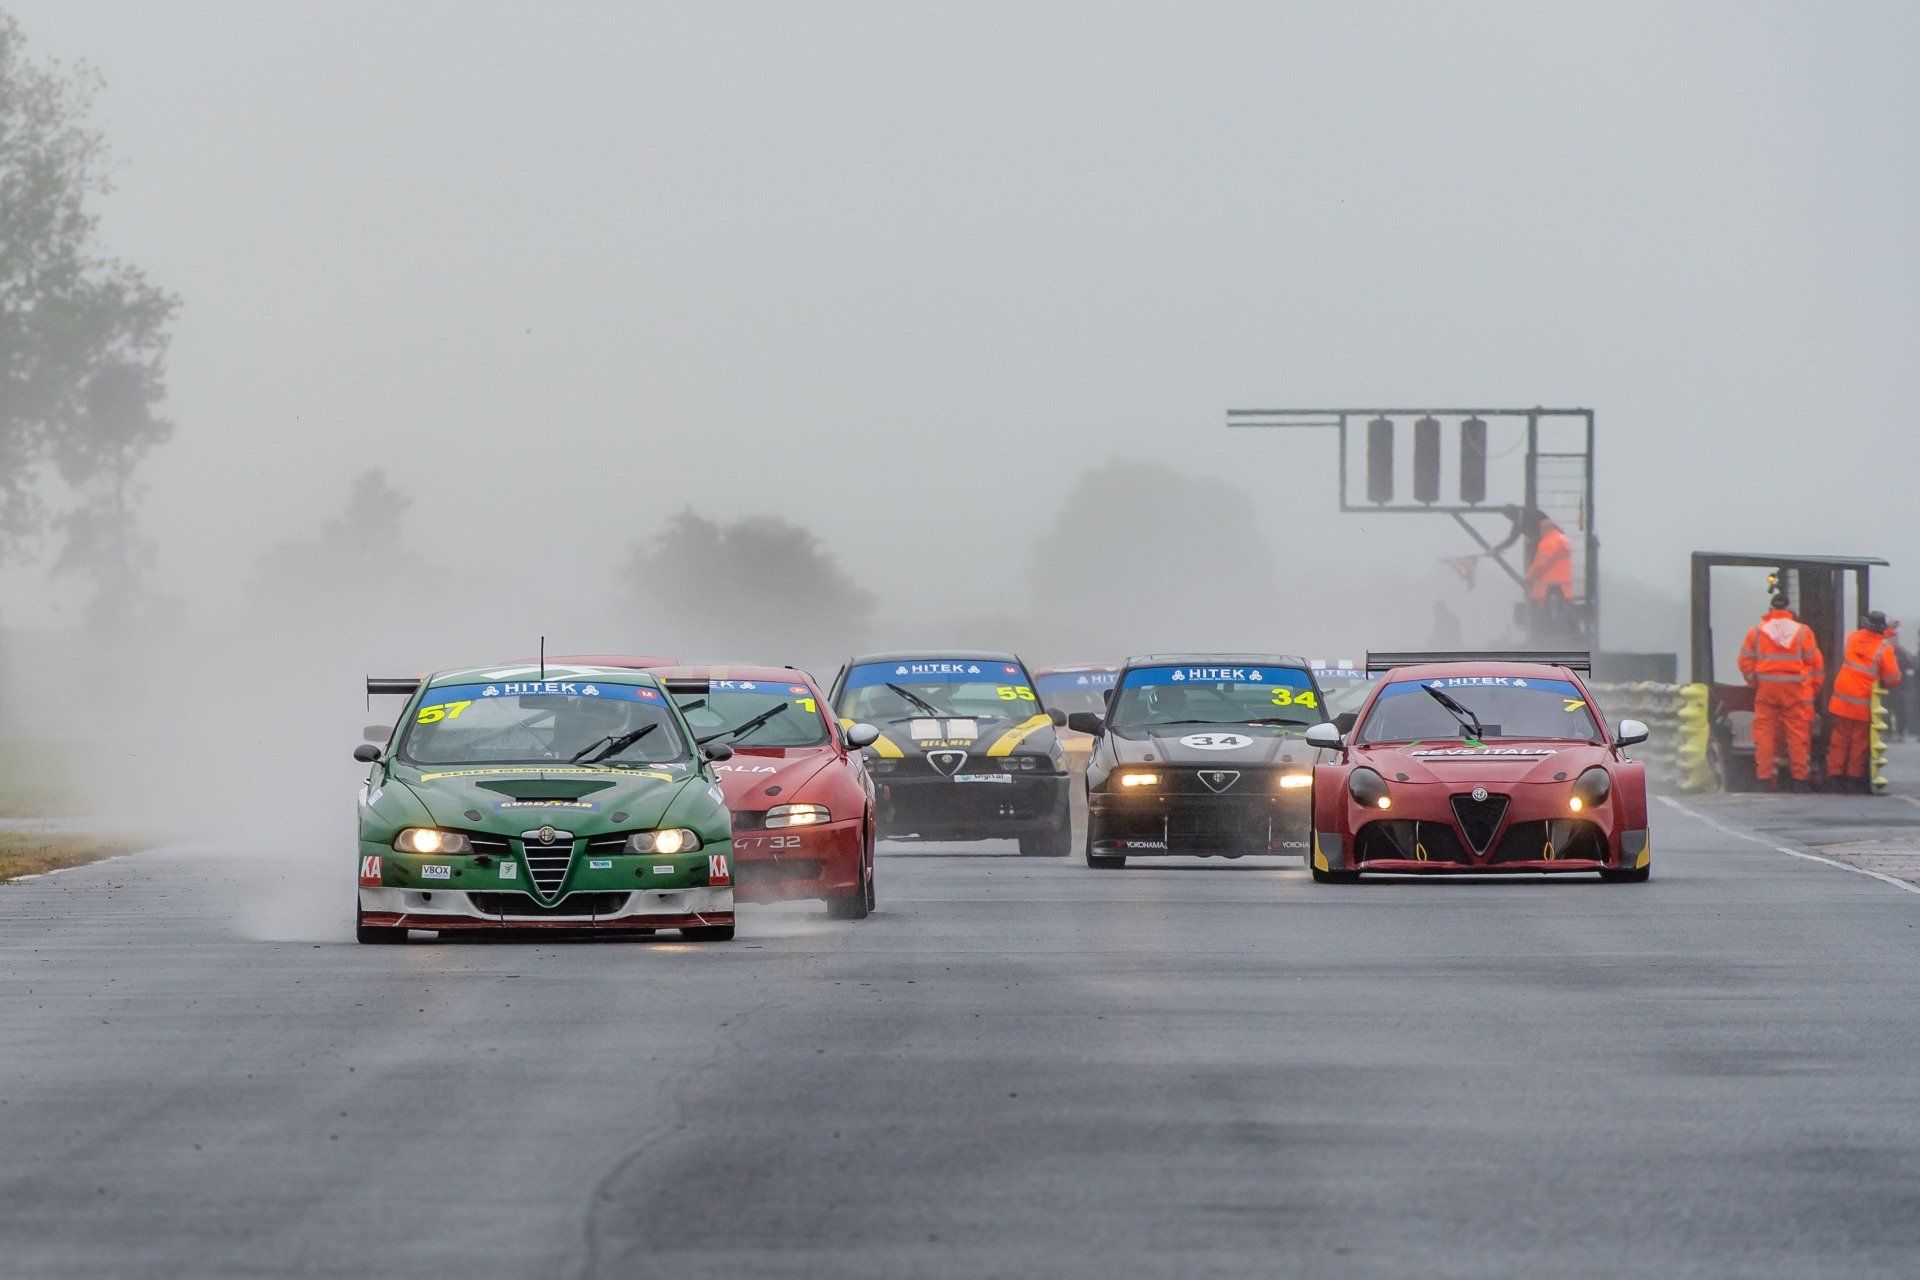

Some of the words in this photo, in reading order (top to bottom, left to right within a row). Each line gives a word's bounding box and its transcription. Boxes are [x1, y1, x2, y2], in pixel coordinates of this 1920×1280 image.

[912, 664, 964, 672] HITEK
[1189, 668, 1245, 678] HITEK
[504, 683, 577, 692] HITEK
[1448, 677, 1508, 685] HITEK
[996, 686, 1036, 701] 55
[1271, 688, 1318, 709] 34
[795, 698, 816, 713] 1
[1563, 699, 1586, 712] 7
[417, 701, 472, 725] 57
[1191, 736, 1240, 746] 34
[500, 800, 593, 808] GOODYEAR
[734, 837, 767, 850] GT
[360, 856, 382, 878] KA
[423, 866, 449, 875] VBOX
[708, 854, 730, 877] KA
